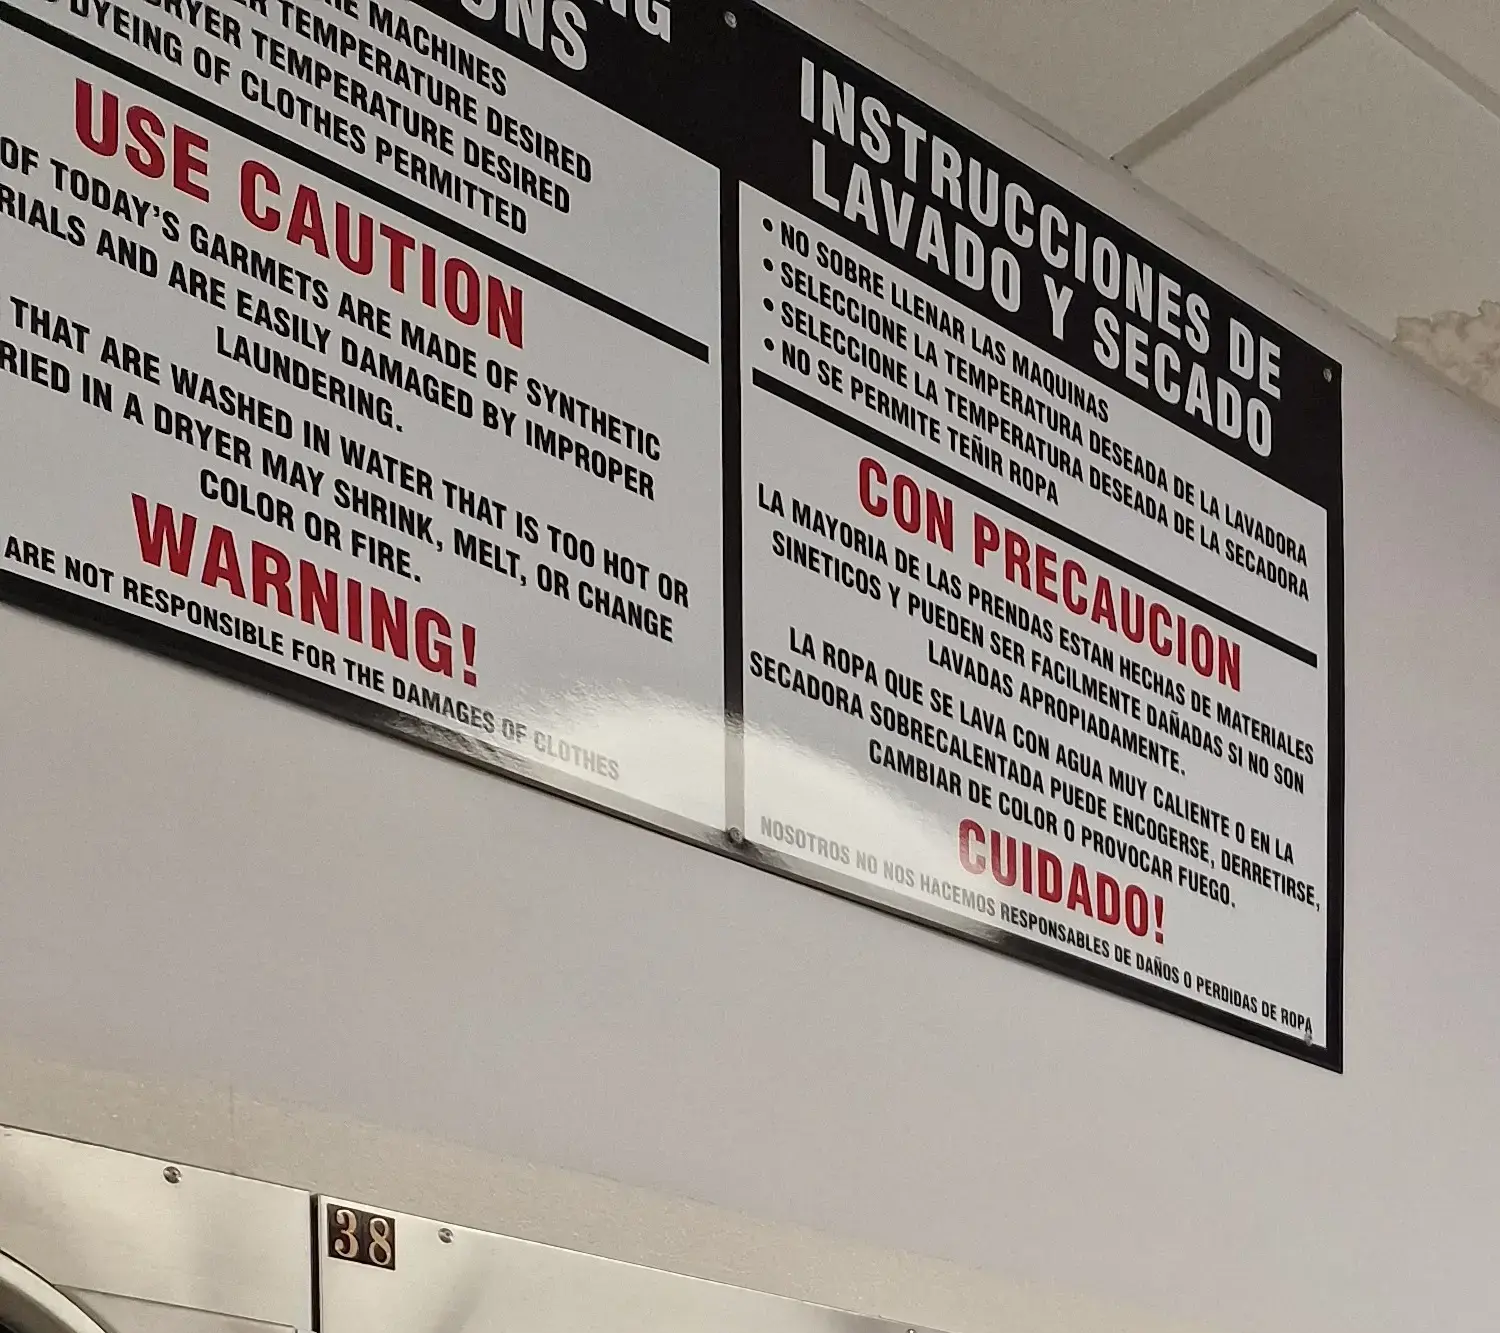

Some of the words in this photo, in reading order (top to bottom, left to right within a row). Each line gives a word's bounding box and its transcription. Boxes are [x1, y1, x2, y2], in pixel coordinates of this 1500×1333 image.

[193, 41, 233, 89] OF
[241, 69, 367, 155] CLOTHES
[374, 134, 527, 235] PERMITTED
[251, 28, 454, 157] TEMPERATURE
[463, 136, 570, 214] DESIRED
[282, 2, 477, 126] TEMPERATURE
[486, 106, 591, 183] DESIRED
[0, 136, 39, 176] OF
[50, 157, 180, 243] TODAY'S
[190, 223, 329, 310] GARMETS
[337, 291, 392, 339] ARE
[401, 318, 477, 379] MADE
[486, 359, 518, 394] OF
[526, 377, 660, 461] SYNTHETIC
[75, 77, 210, 204] USE
[240, 159, 524, 350] CAUTION
[800, 56, 1210, 355] INSTRUCCIONES
[1229, 317, 1281, 401] DE
[812, 138, 1021, 313] LAVADO
[1043, 273, 1074, 342] Y
[1093, 306, 1272, 459] SECADO
[96, 228, 157, 279] AND
[168, 259, 226, 311] ARE
[236, 288, 331, 355] EASILY
[342, 335, 473, 419] DAMAGED
[482, 399, 517, 438] BY
[526, 419, 654, 501] IMPROPER
[216, 321, 404, 433] LAUNDERING.
[782, 339, 810, 376] NO
[817, 359, 843, 394] SE
[851, 375, 940, 445] PERMITE
[947, 426, 1003, 477] TEÑIR
[1009, 458, 1059, 506] ROPA
[131, 492, 477, 688] WARNING!
[200, 468, 295, 533] COLOR
[305, 511, 342, 552] OR
[351, 529, 421, 584] FIRE.
[859, 457, 954, 554] CON
[973, 511, 1241, 693] PRECAUCION
[4, 535, 56, 576] ARE
[64, 554, 115, 594] NOT
[123, 575, 285, 657] RESPONSIBLE
[291, 638, 337, 677] FOR
[342, 657, 386, 695] THE
[392, 675, 496, 738] DAMAGES
[500, 716, 527, 744] OF
[533, 728, 620, 781] CLOTHES
[928, 638, 1013, 698] LAVADAS
[1019, 681, 1186, 777] APROPIADAMENTE.
[750, 651, 863, 720] SECADORA
[870, 701, 1044, 795] SOBRECALENTADA
[1051, 776, 1107, 821] PUEDE
[1113, 802, 1215, 869] ENCOGERSE,
[1221, 849, 1320, 912] DERRETIRSE,
[869, 738, 962, 798] CAMBIAR
[968, 778, 993, 810] DE
[999, 791, 1058, 837] COLOR
[1063, 818, 1075, 843] O
[1081, 824, 1173, 884] PROVOCAR
[1178, 864, 1235, 908] FUEGO.
[760, 815, 850, 865] NOSOTROS
[856, 850, 878, 874] NO
[883, 860, 915, 888] NOS
[920, 873, 996, 921] HACEMOS
[1000, 902, 1110, 959] RESPONSABLES
[1114, 944, 1132, 967] DE
[1135, 952, 1180, 985] DAÑOS
[1184, 970, 1192, 989] O
[1196, 975, 1258, 1015] PERDIDAS
[1262, 1000, 1277, 1022] DE
[1281, 1007, 1313, 1039] ROPA
[959, 818, 1165, 947] CUIDADO!
[334, 1209, 393, 1266] 38
